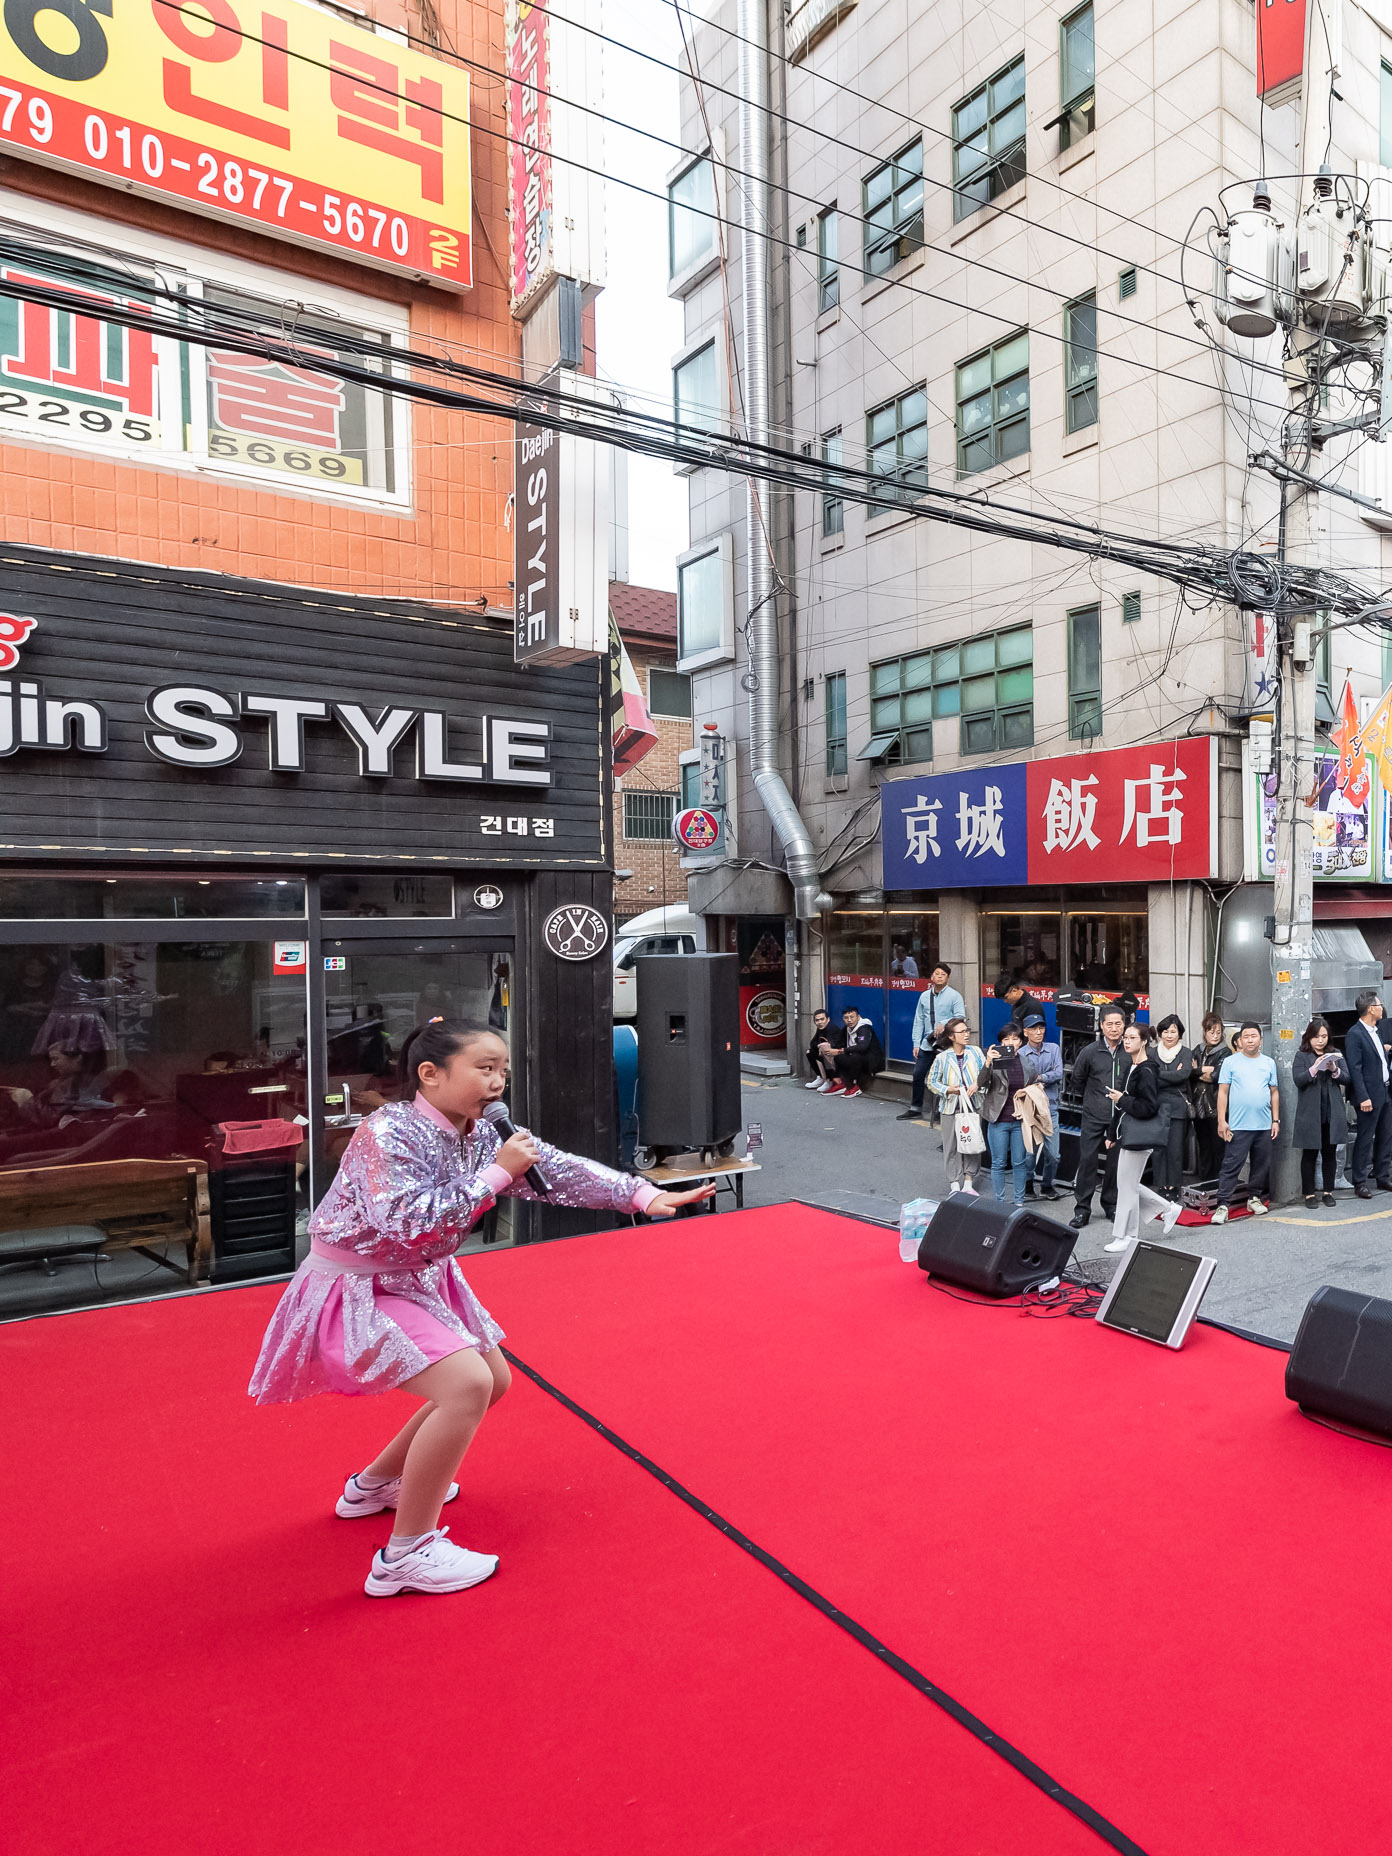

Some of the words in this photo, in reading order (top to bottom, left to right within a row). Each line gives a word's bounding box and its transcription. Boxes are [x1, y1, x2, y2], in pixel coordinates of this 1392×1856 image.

[84, 118, 410, 258] 010-2877-5670
[520, 27, 543, 275] 노래연습장
[209, 428, 348, 478] 5669
[521, 426, 554, 466] Daejin
[527, 467, 548, 648] STYLE
[148, 684, 554, 786] STYLE
[479, 814, 555, 838] 건대점
